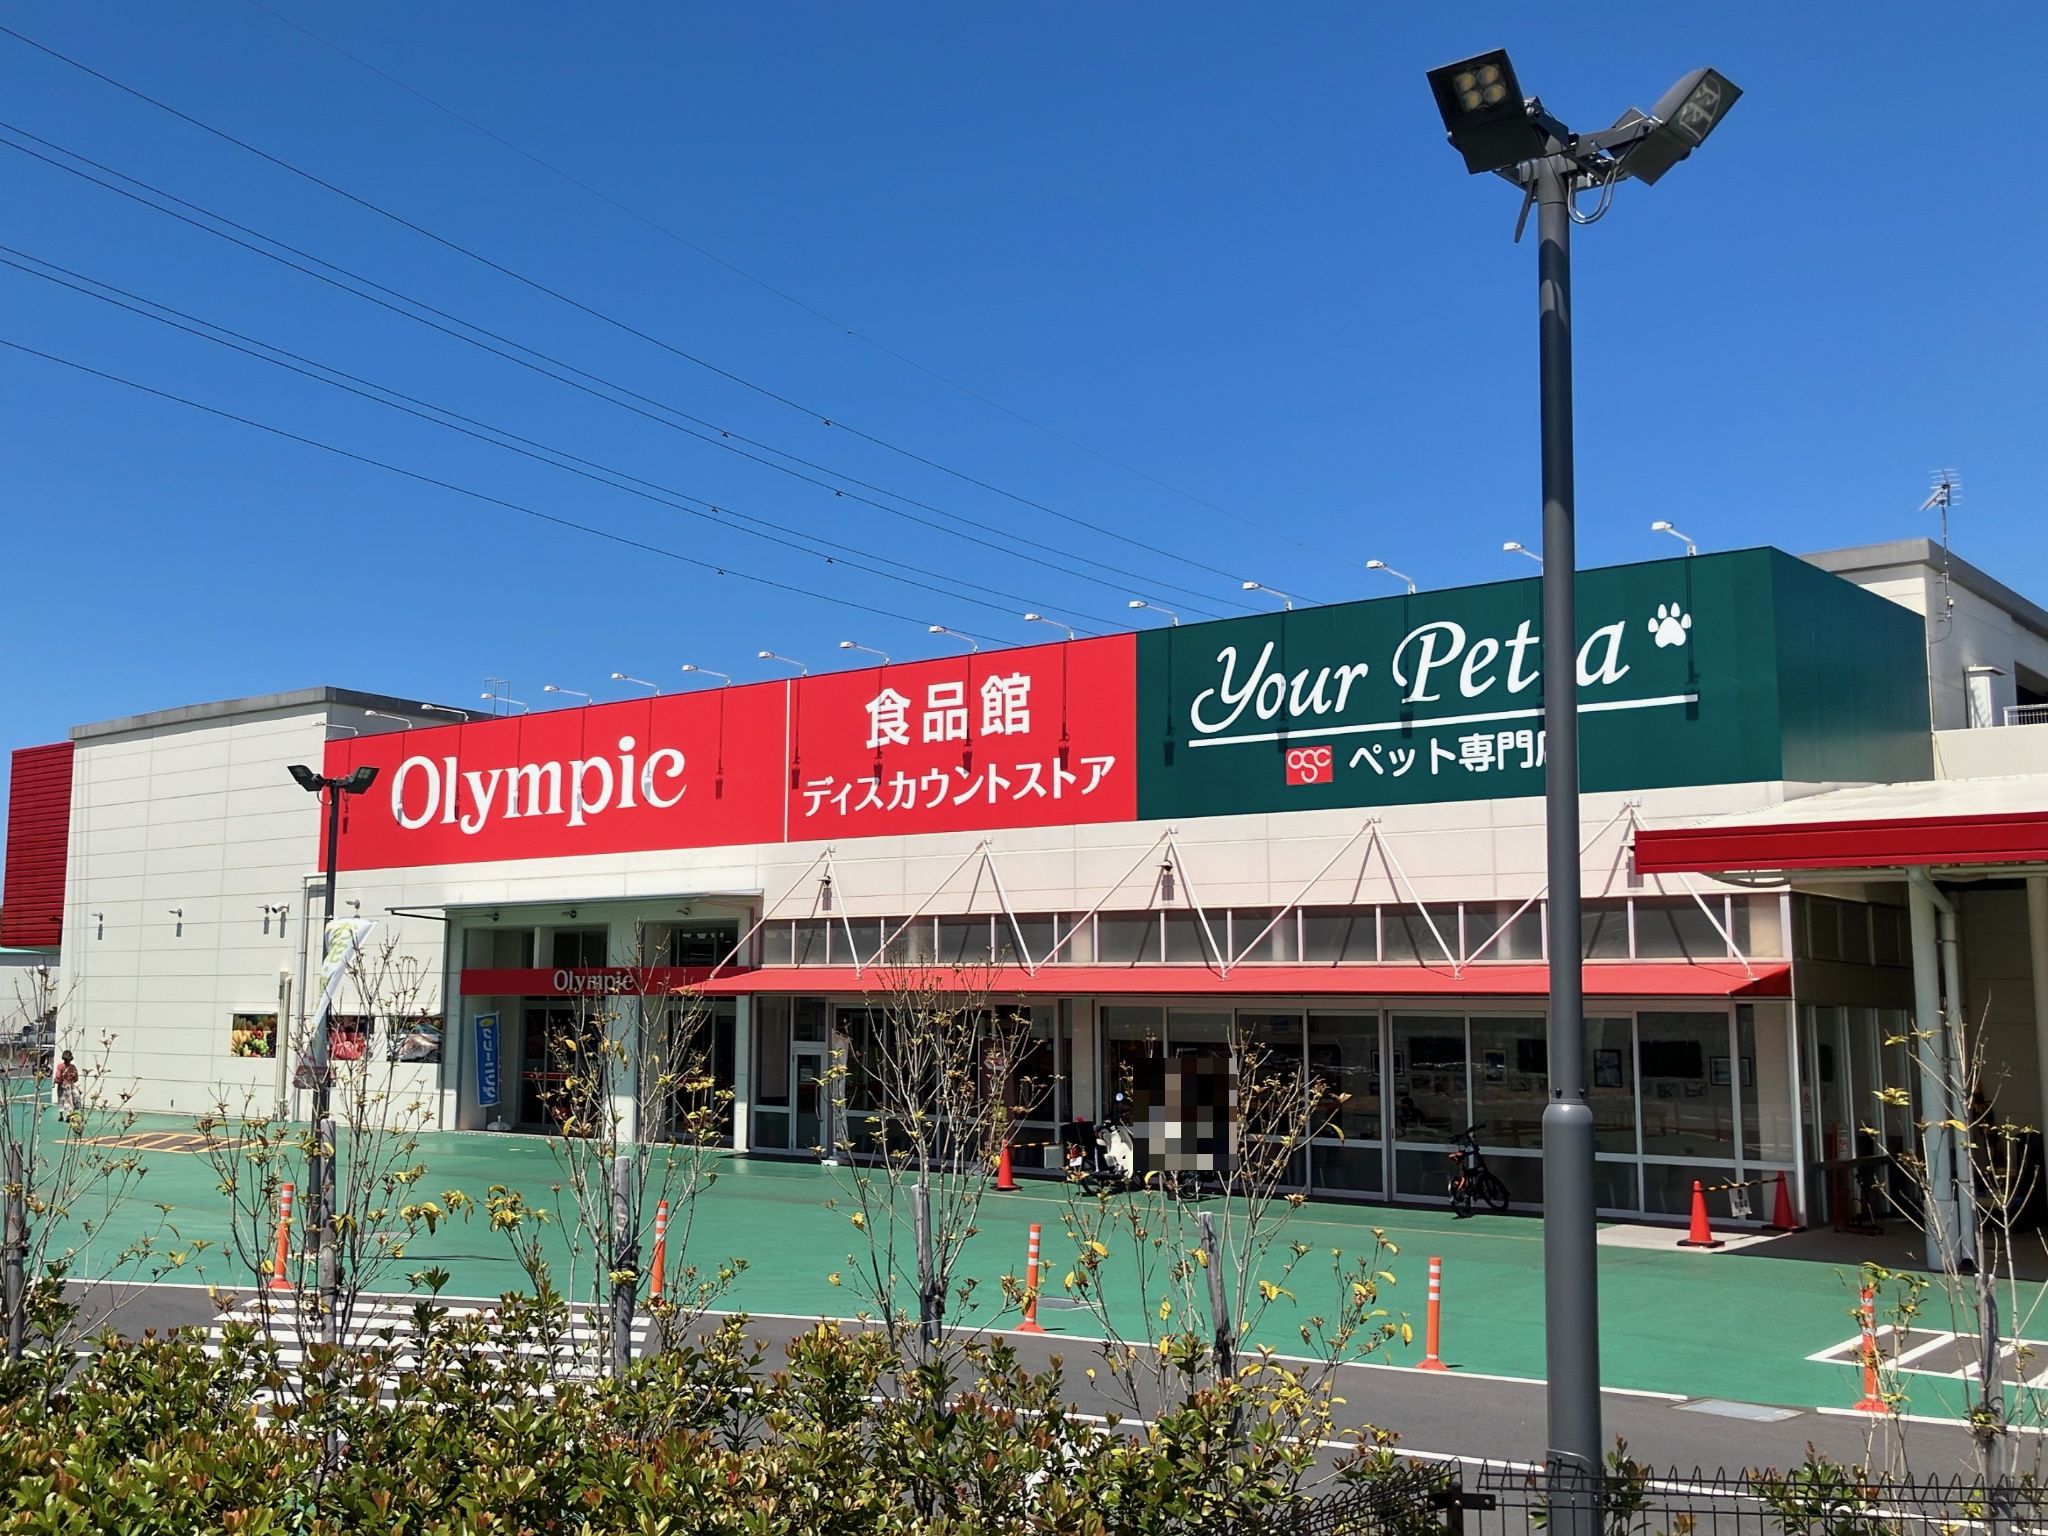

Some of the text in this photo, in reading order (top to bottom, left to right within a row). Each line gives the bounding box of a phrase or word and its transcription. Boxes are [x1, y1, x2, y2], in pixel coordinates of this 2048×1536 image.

[865, 671, 1032, 750] 食品館
[1189, 618, 1632, 735] Your Peta
[390, 735, 688, 836] Olympic
[802, 755, 1117, 818] ディスカウントストア
[553, 969, 635, 994] Olympic
